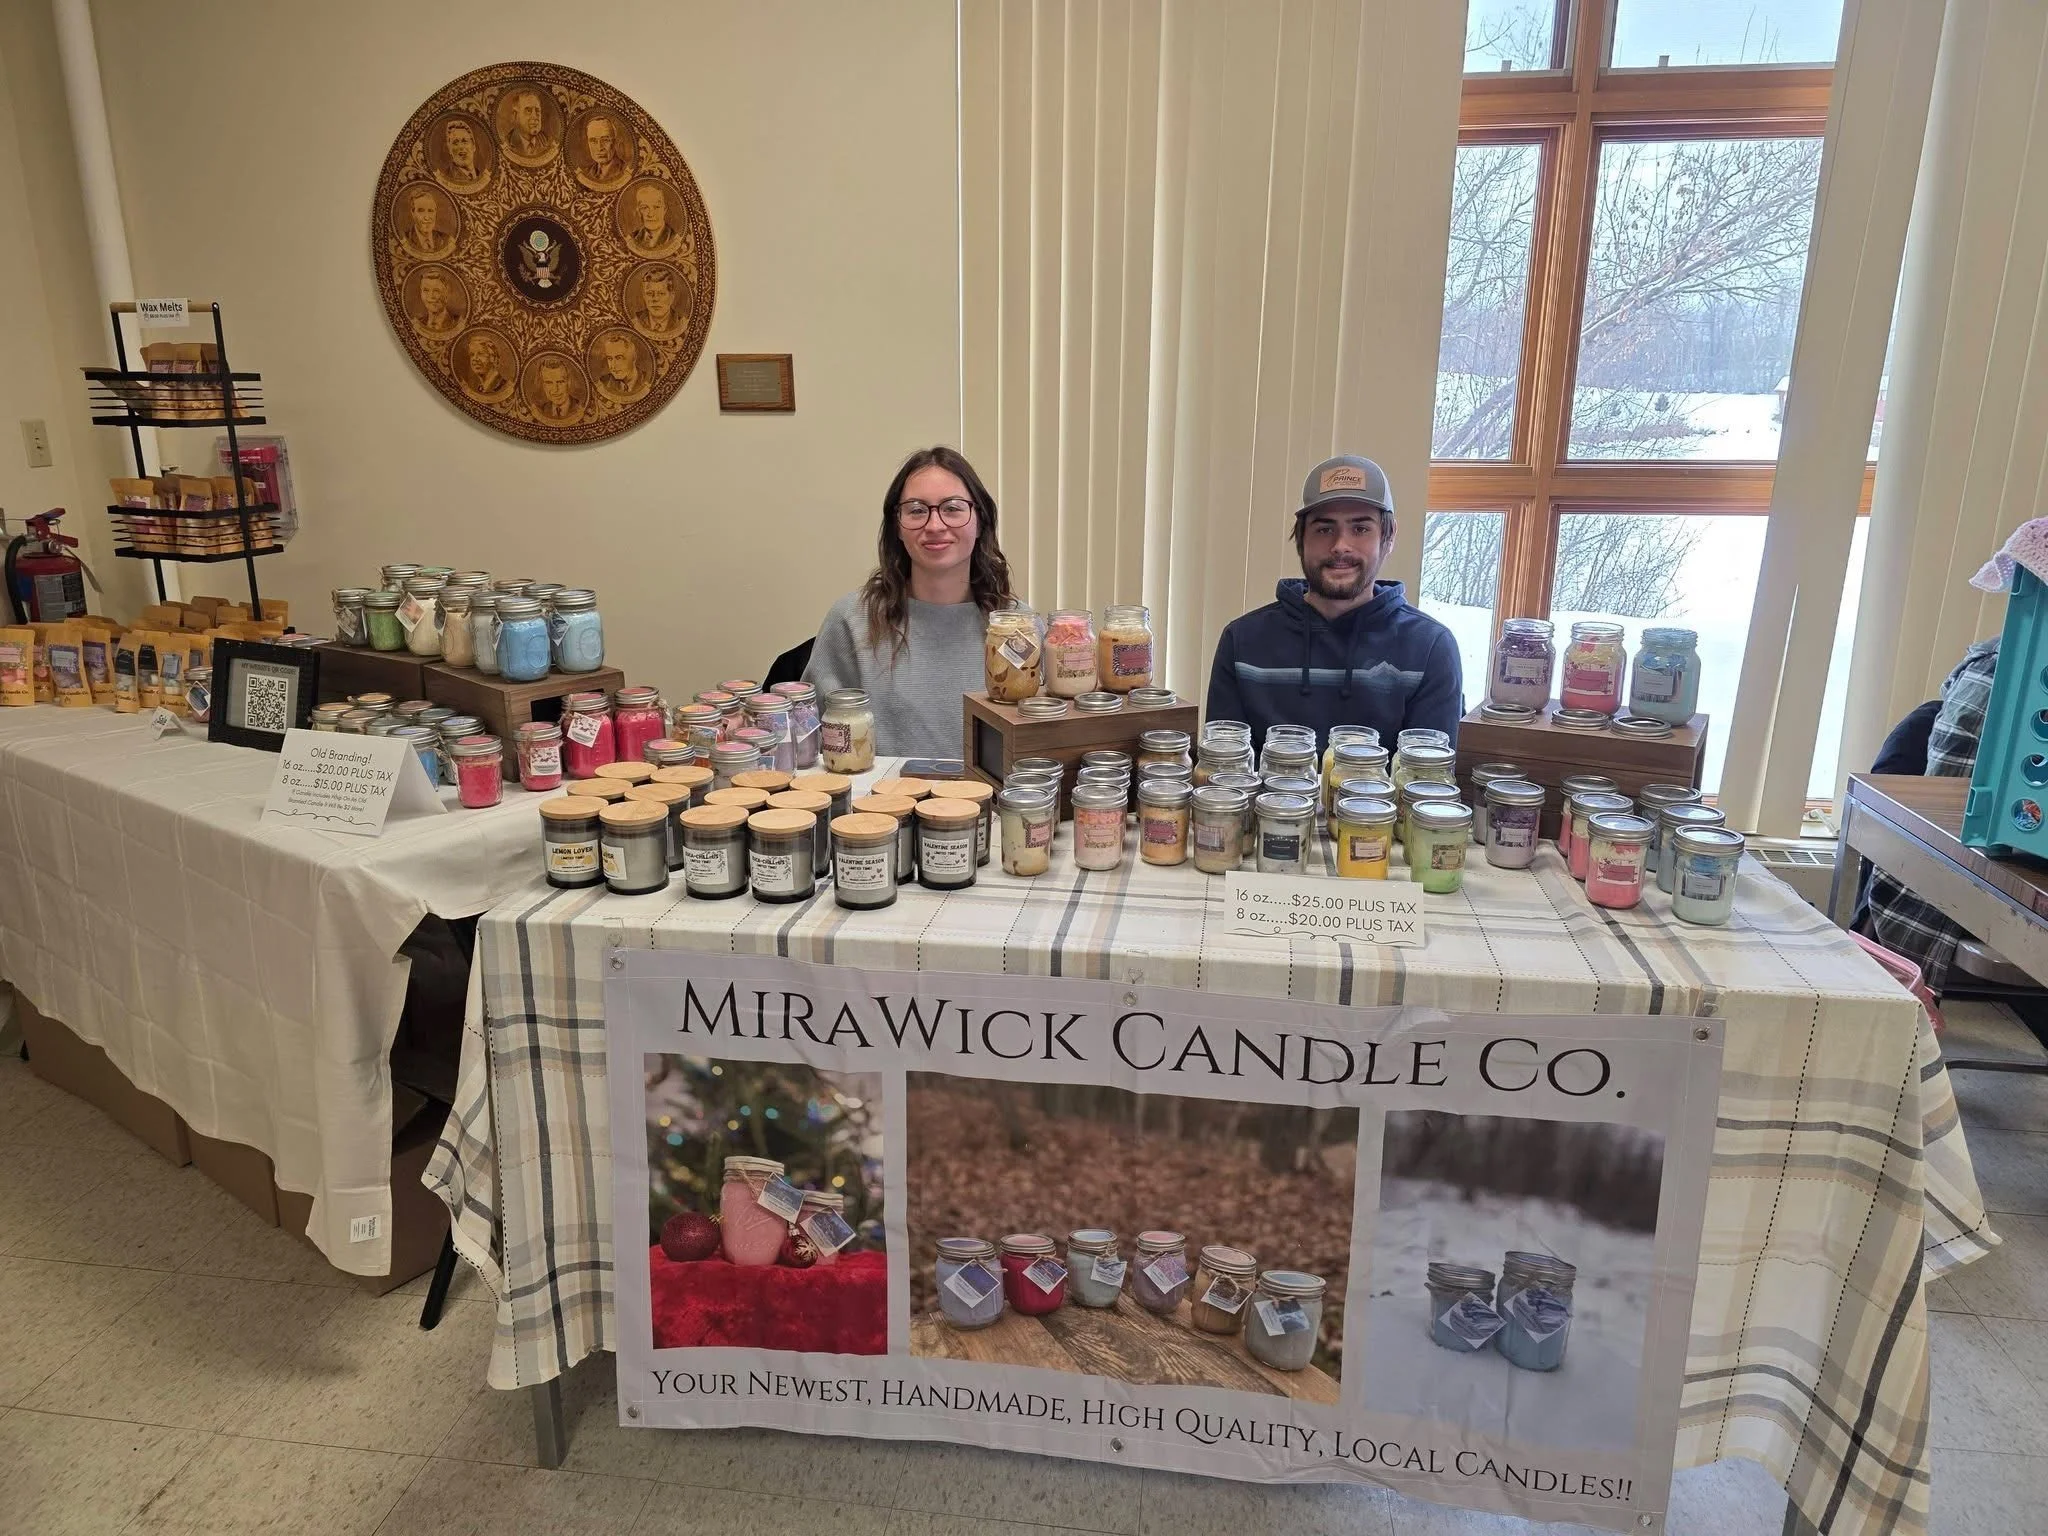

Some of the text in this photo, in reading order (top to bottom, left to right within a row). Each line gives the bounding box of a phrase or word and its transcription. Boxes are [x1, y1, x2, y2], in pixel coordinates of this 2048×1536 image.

[140, 301, 183, 312] Wax Melts
[310, 747, 373, 766] Old Branding!
[282, 759, 291, 770] 16
[350, 768, 373, 780] PLUS
[375, 770, 394, 782] TAX
[281, 774, 289, 784] 8
[344, 782, 368, 794] PLUS
[370, 785, 388, 797] TAX
[552, 846, 594, 855] LEMON LOVER
[924, 842, 949, 850] VALENTINE
[838, 857, 884, 866] VALENTINE SEASON
[1235, 888, 1248, 902] 16
[1349, 899, 1385, 913] PLUS
[1389, 901, 1417, 915] TAX
[1236, 907, 1245, 920] 8
[1346, 917, 1383, 931] PLUS
[1387, 919, 1415, 933] TAX
